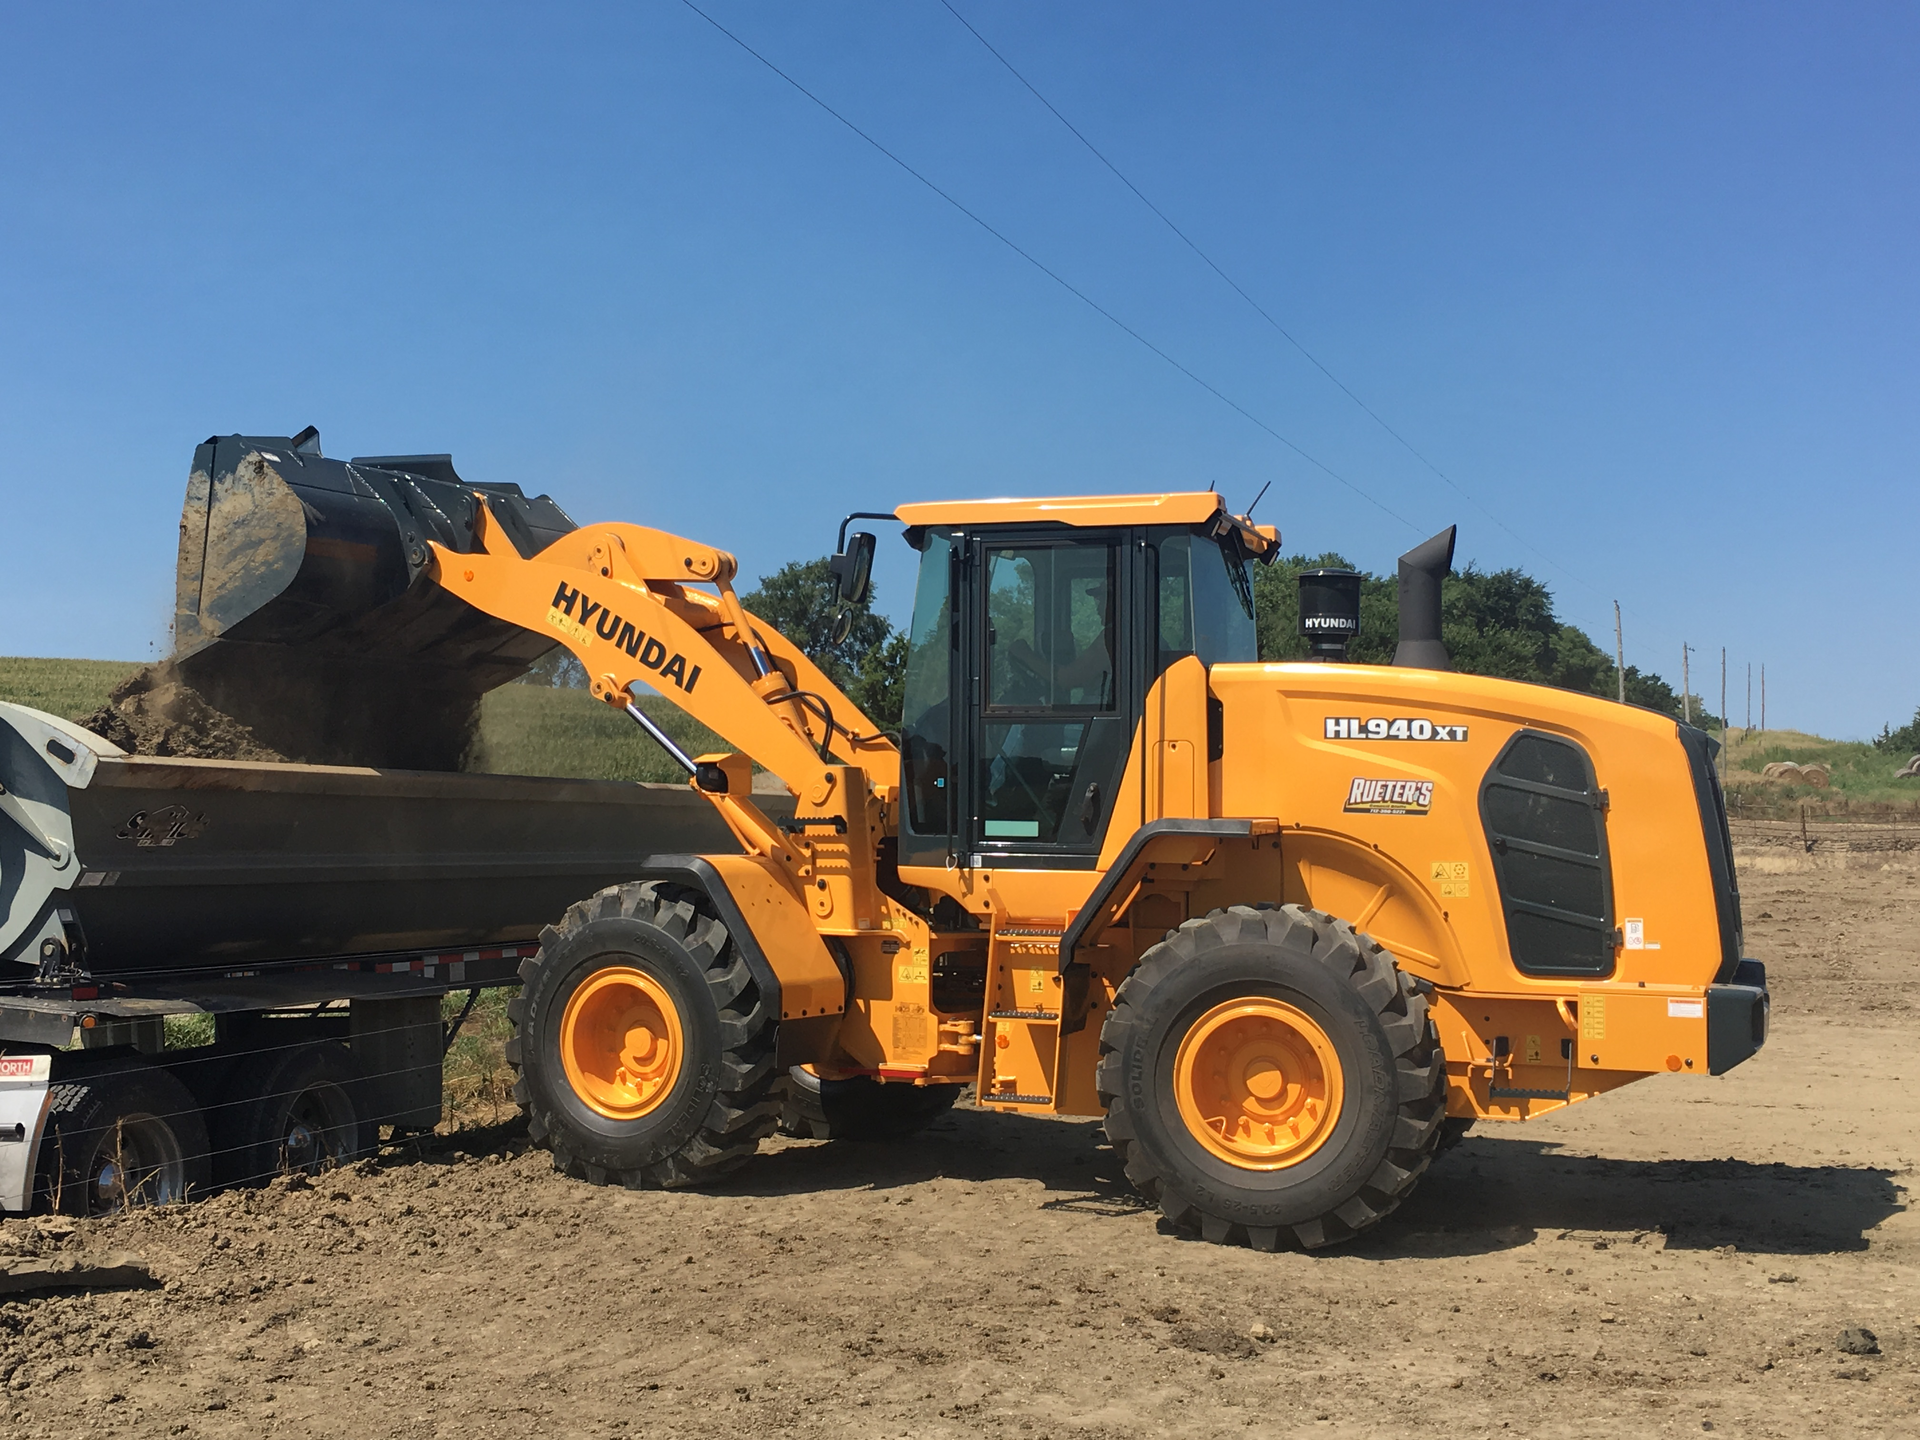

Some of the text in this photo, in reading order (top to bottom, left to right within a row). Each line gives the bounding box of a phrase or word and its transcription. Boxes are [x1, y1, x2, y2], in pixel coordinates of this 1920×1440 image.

[1305, 616, 1356, 629] HYUNDAI
[551, 581, 702, 694] HYUNDAI
[1349, 778, 1434, 805] RUETER'S
[0, 1061, 31, 1072] ORTH
